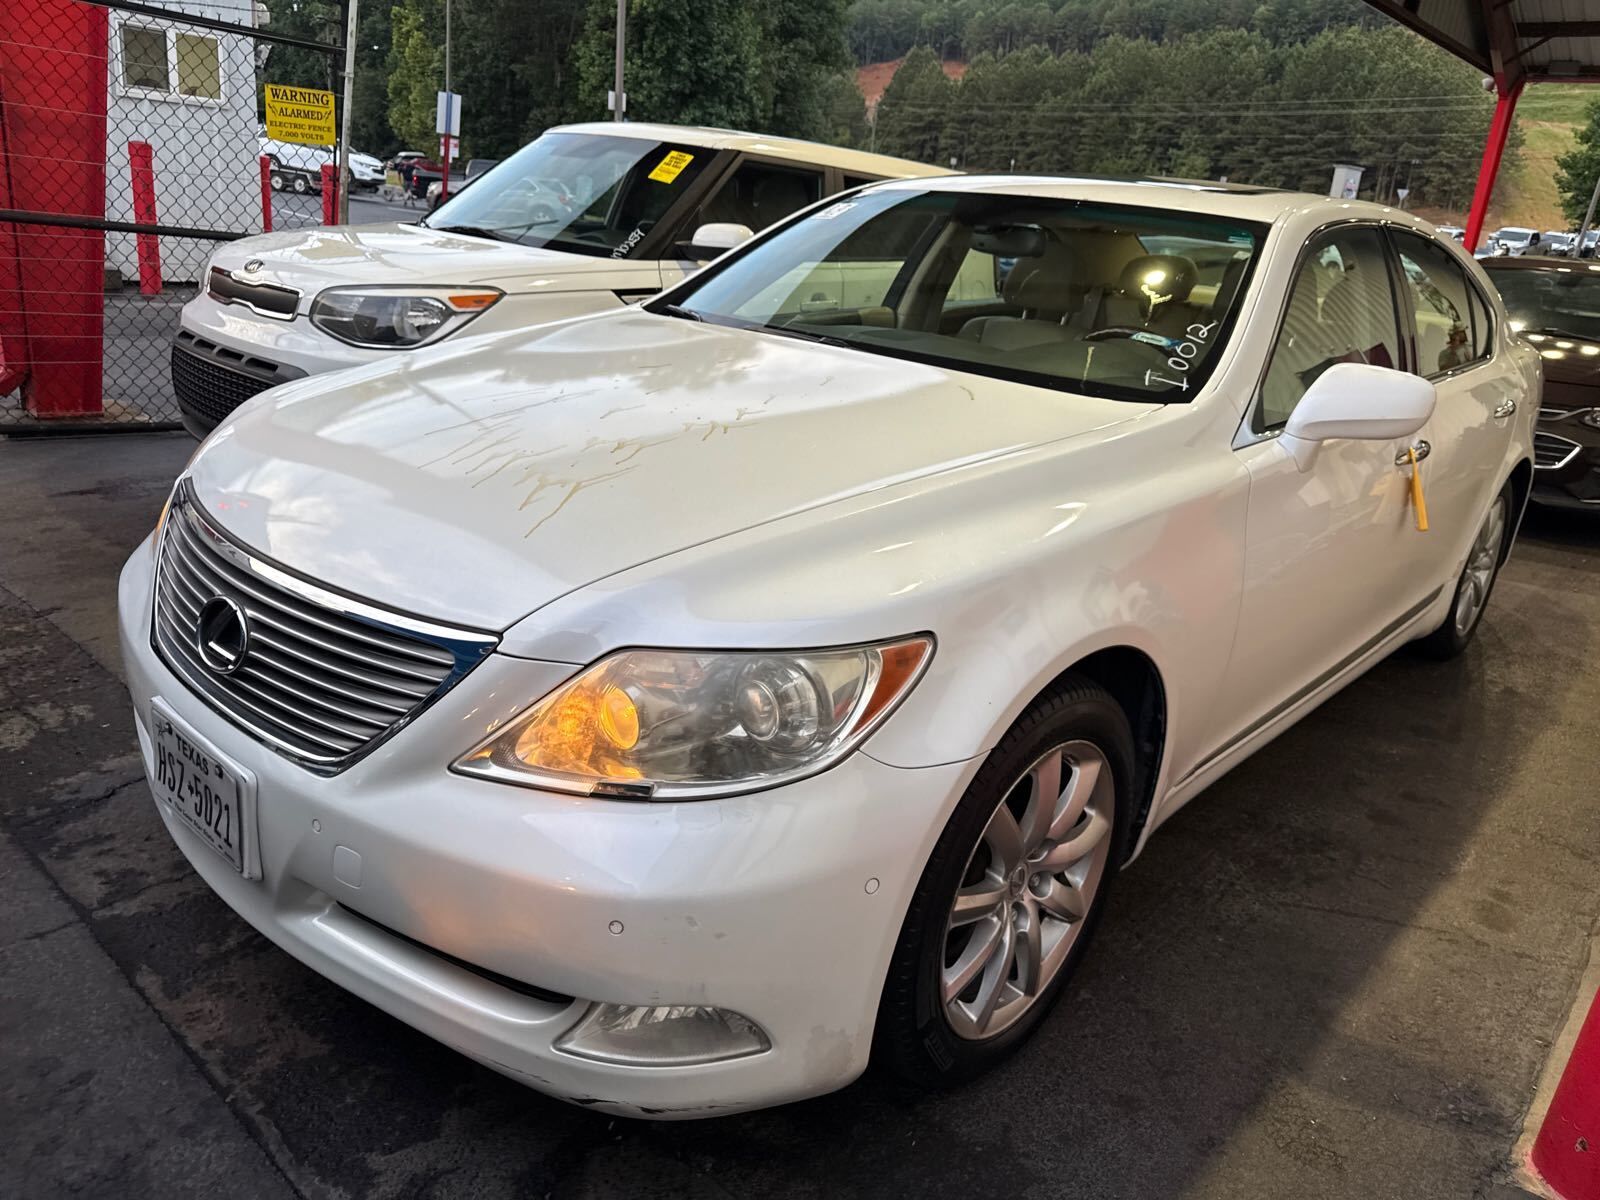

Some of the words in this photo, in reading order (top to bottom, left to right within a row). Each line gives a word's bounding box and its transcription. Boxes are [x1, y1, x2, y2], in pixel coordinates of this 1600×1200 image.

[270, 87, 330, 106] WARNING
[278, 106, 323, 121] ALARMED
[269, 120, 306, 129] ELECTRIC
[308, 124, 332, 132] FENCE
[300, 132, 324, 140] VOLTS
[176, 733, 209, 776] TEXAS
